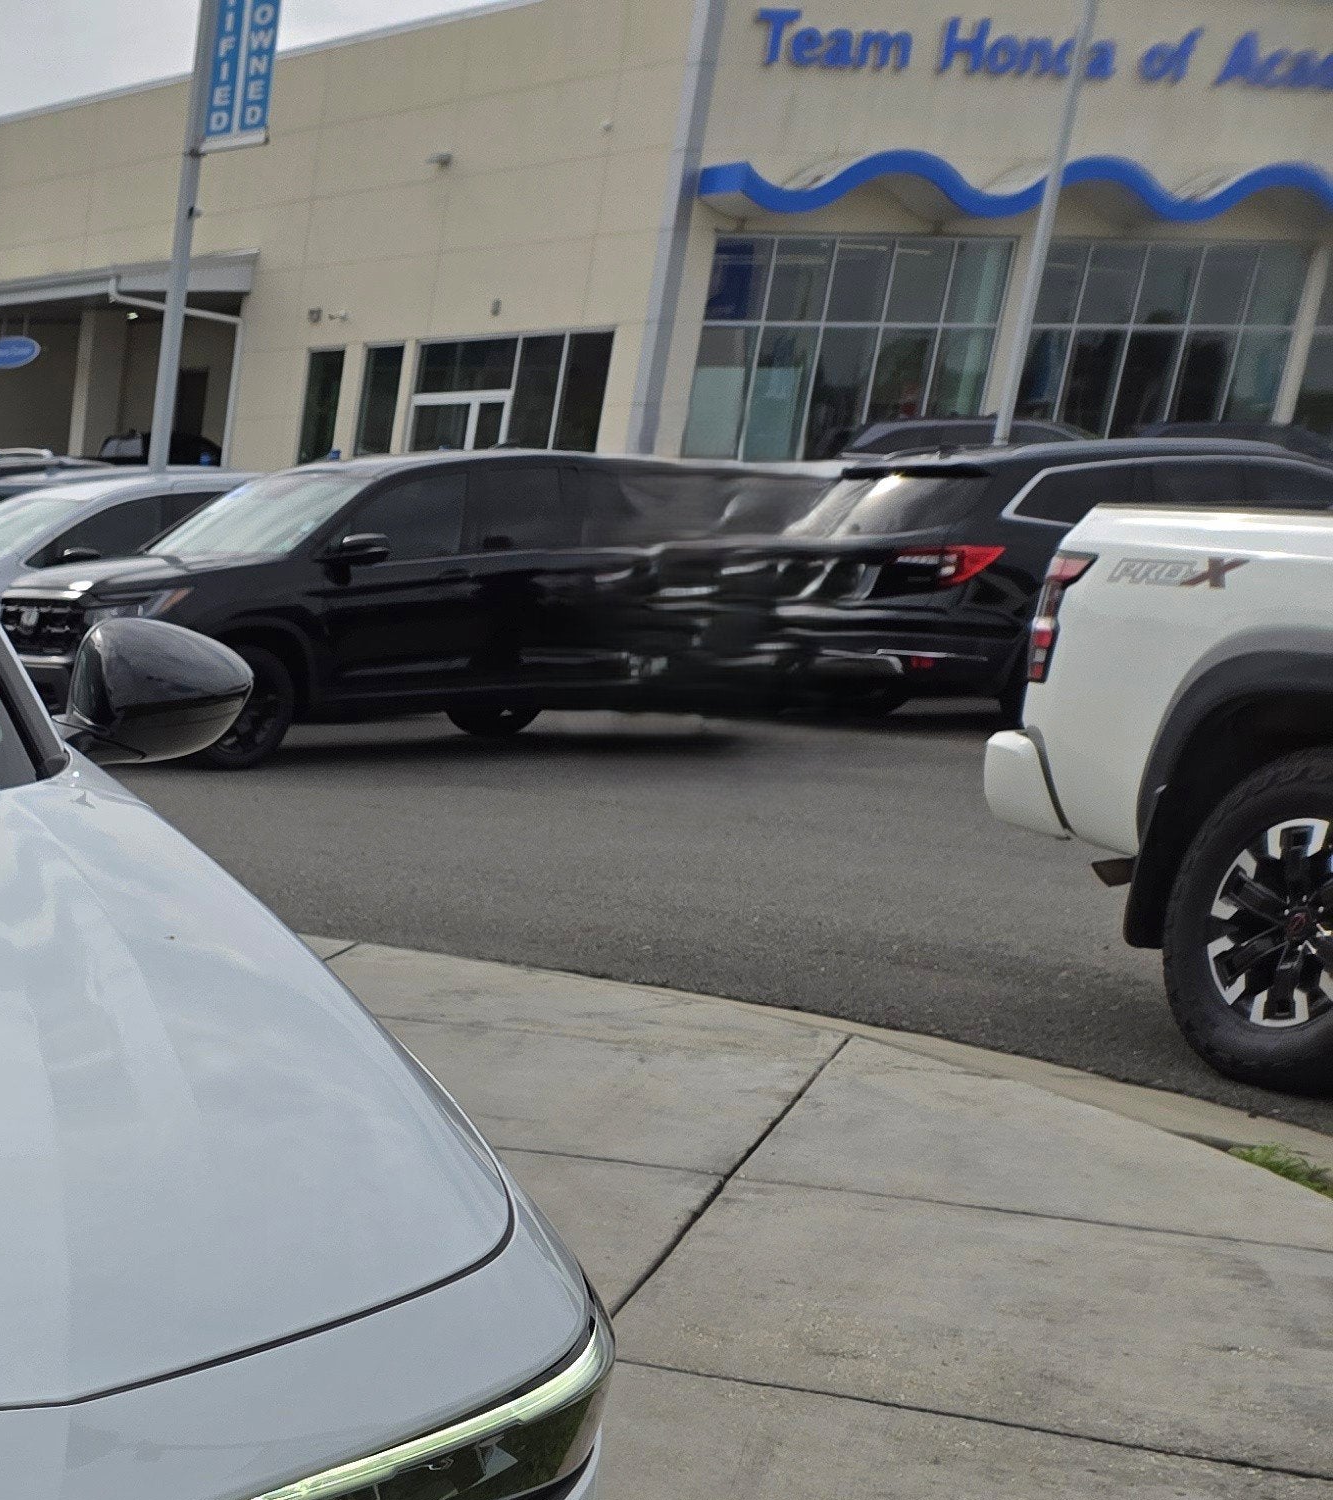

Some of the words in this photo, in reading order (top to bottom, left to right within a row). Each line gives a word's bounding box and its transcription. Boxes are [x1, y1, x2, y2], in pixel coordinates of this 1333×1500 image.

[209, 0, 237, 131] IFIED
[757, 8, 915, 71] Team
[1138, 26, 1203, 85] of
